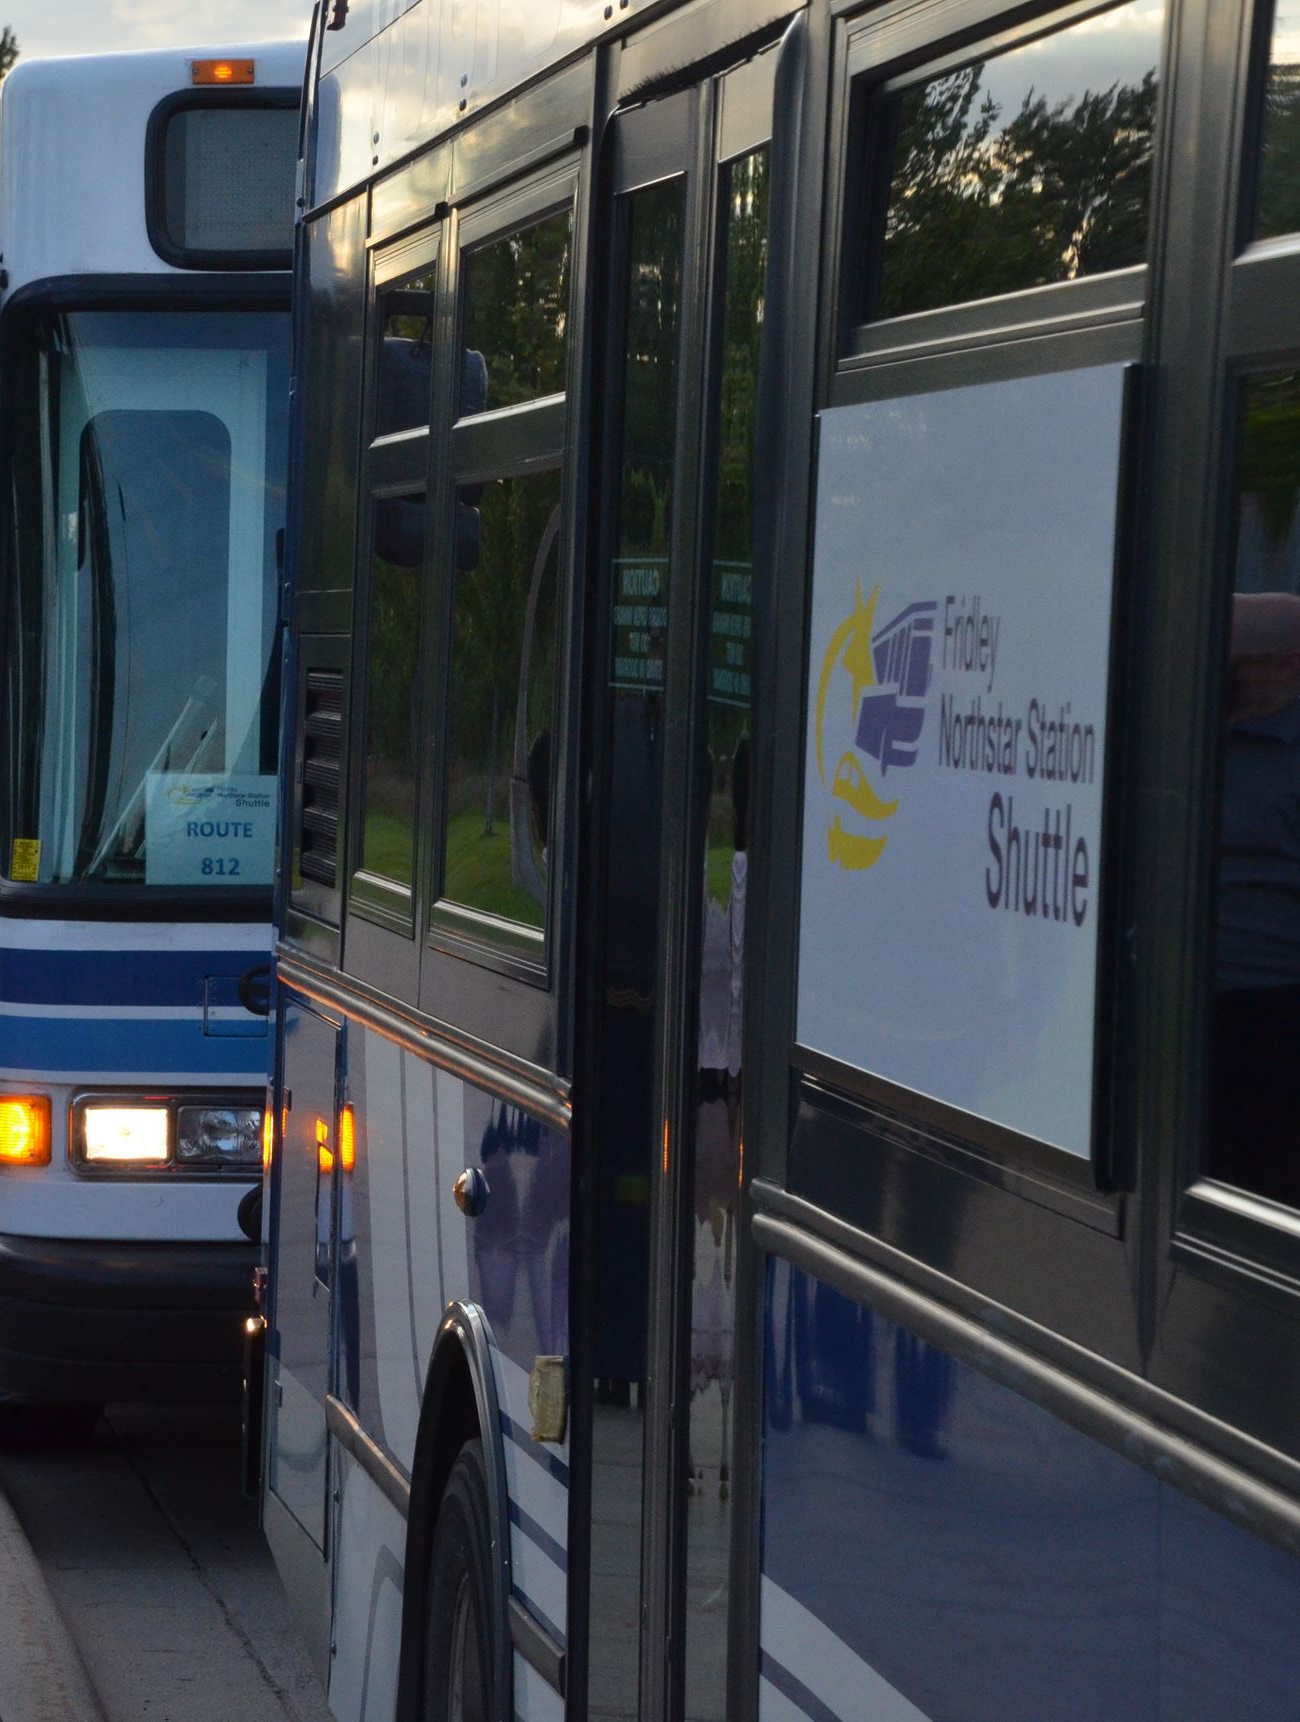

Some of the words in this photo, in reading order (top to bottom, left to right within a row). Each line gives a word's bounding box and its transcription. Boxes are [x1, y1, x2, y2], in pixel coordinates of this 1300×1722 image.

[943, 595, 1000, 693] Fridley
[938, 693, 1023, 776] Northstar
[1026, 697, 1096, 784] Station
[186, 821, 253, 838] ROUTE
[235, 798, 270, 808] Shuttle
[201, 857, 240, 876] 812
[985, 790, 1090, 928] Shuttle
